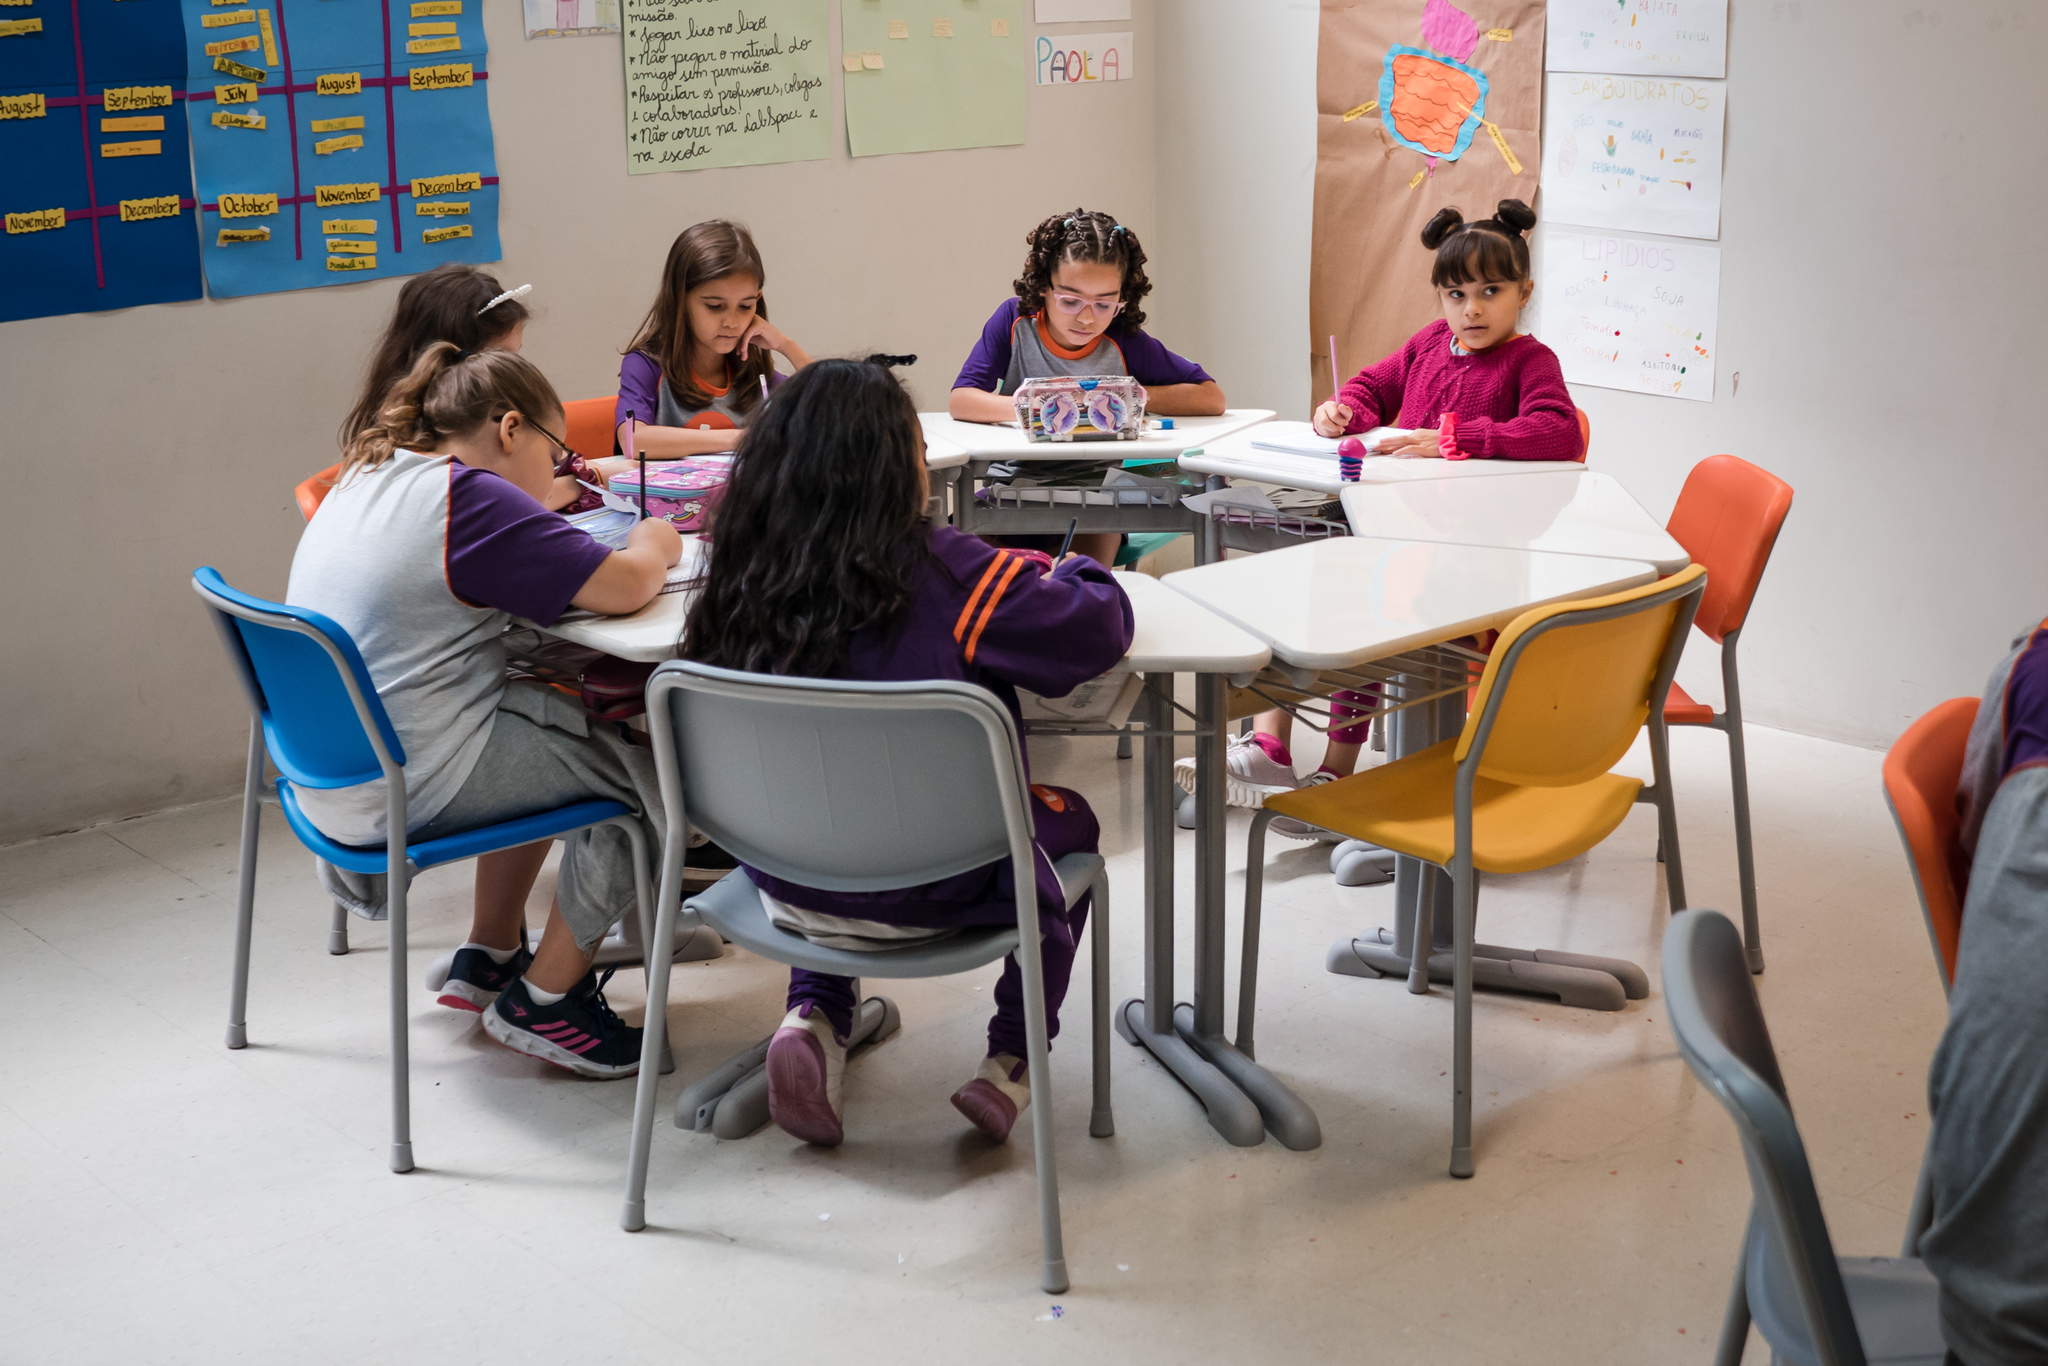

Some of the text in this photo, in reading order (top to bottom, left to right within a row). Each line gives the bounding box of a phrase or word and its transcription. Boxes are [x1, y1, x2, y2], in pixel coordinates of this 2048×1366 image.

[628, 7, 677, 23] missão.
[640, 26, 682, 54] Jogar
[686, 18, 715, 41] lixo
[717, 24, 734, 35] no
[639, 33, 812, 75] Não pegar o material do
[1036, 36, 1119, 84] PAOLA
[319, 75, 357, 93] August
[412, 69, 470, 88] September
[632, 61, 772, 91] amigo sem permissão.
[107, 89, 168, 108] September
[224, 86, 248, 102] July
[639, 84, 700, 105] Respeitar
[703, 90, 714, 99] os
[784, 72, 822, 102] colegas
[1567, 77, 1710, 110] CARBOIDRATOS
[639, 124, 669, 145] Não
[671, 126, 712, 141] correr
[715, 121, 737, 137] na
[1573, 113, 1595, 132] PÃO
[633, 151, 654, 164] na
[320, 187, 376, 203] November
[417, 177, 477, 197] December
[124, 198, 178, 219] December
[223, 196, 274, 214] October
[9, 210, 62, 231] November
[1582, 238, 1675, 272] LIPÍDIOS
[1564, 275, 1598, 299] AZEITE
[1652, 285, 1685, 307] SOJA
[1604, 295, 1647, 322] LINHAÇA
[1580, 315, 1613, 337] TOMATE
[1678, 347, 1703, 368] OVO
[1638, 372, 1673, 392] NOZES
